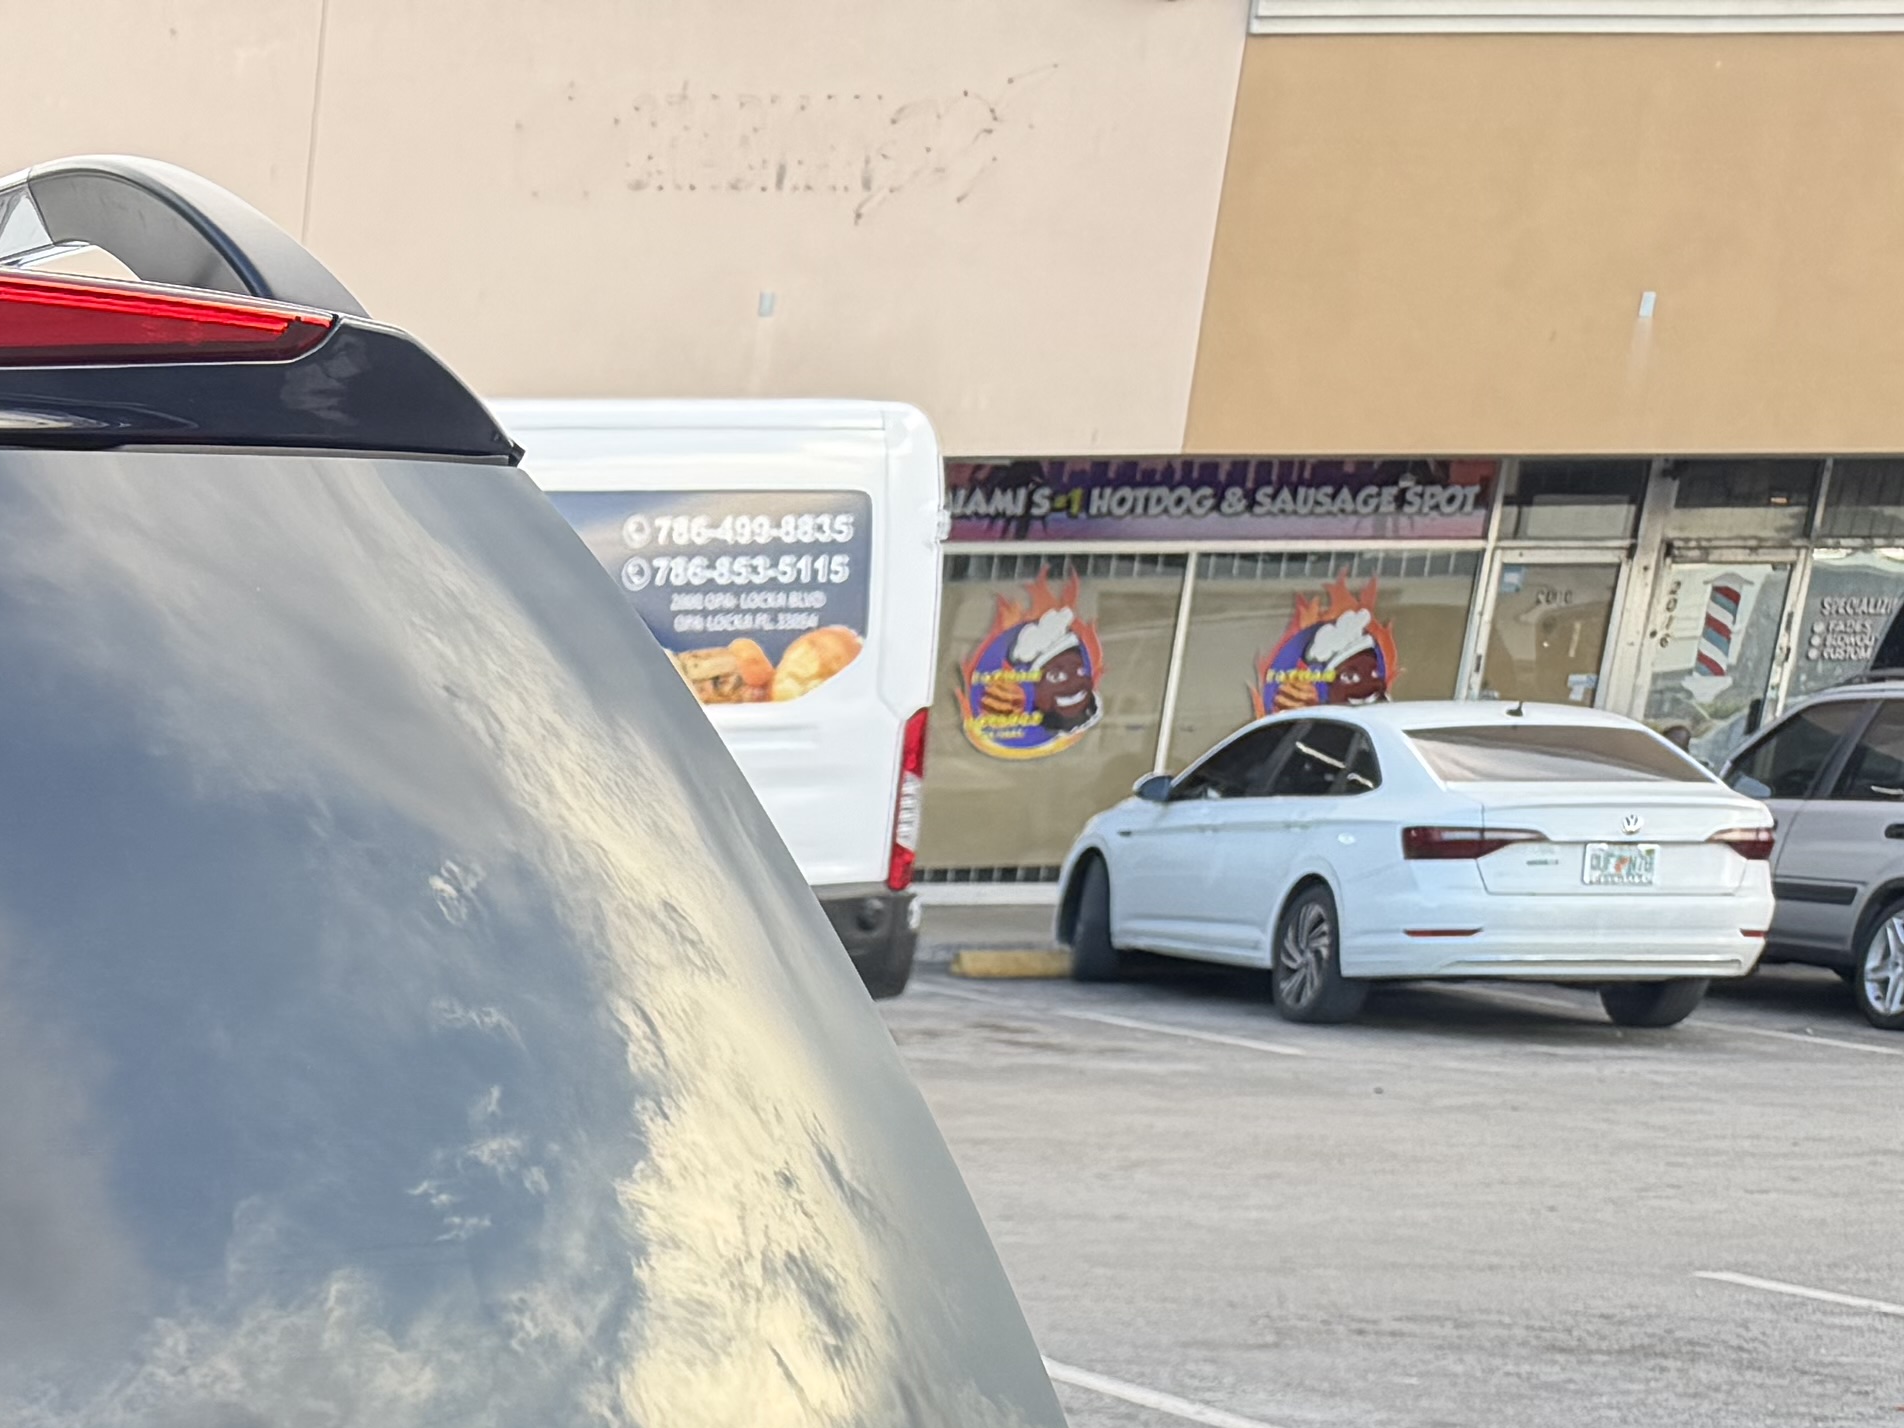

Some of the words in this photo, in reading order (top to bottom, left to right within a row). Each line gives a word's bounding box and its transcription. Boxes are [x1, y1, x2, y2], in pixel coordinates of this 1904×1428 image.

[948, 485, 1053, 517] IAMI'S
[1088, 485, 1219, 517] HOTDOG
[1220, 486, 1248, 516] &
[1252, 484, 1399, 516] SAUSAGE
[1401, 484, 1481, 515] SPOT
[654, 513, 855, 546] 786-499-8835
[652, 553, 851, 587] 786-853-5115
